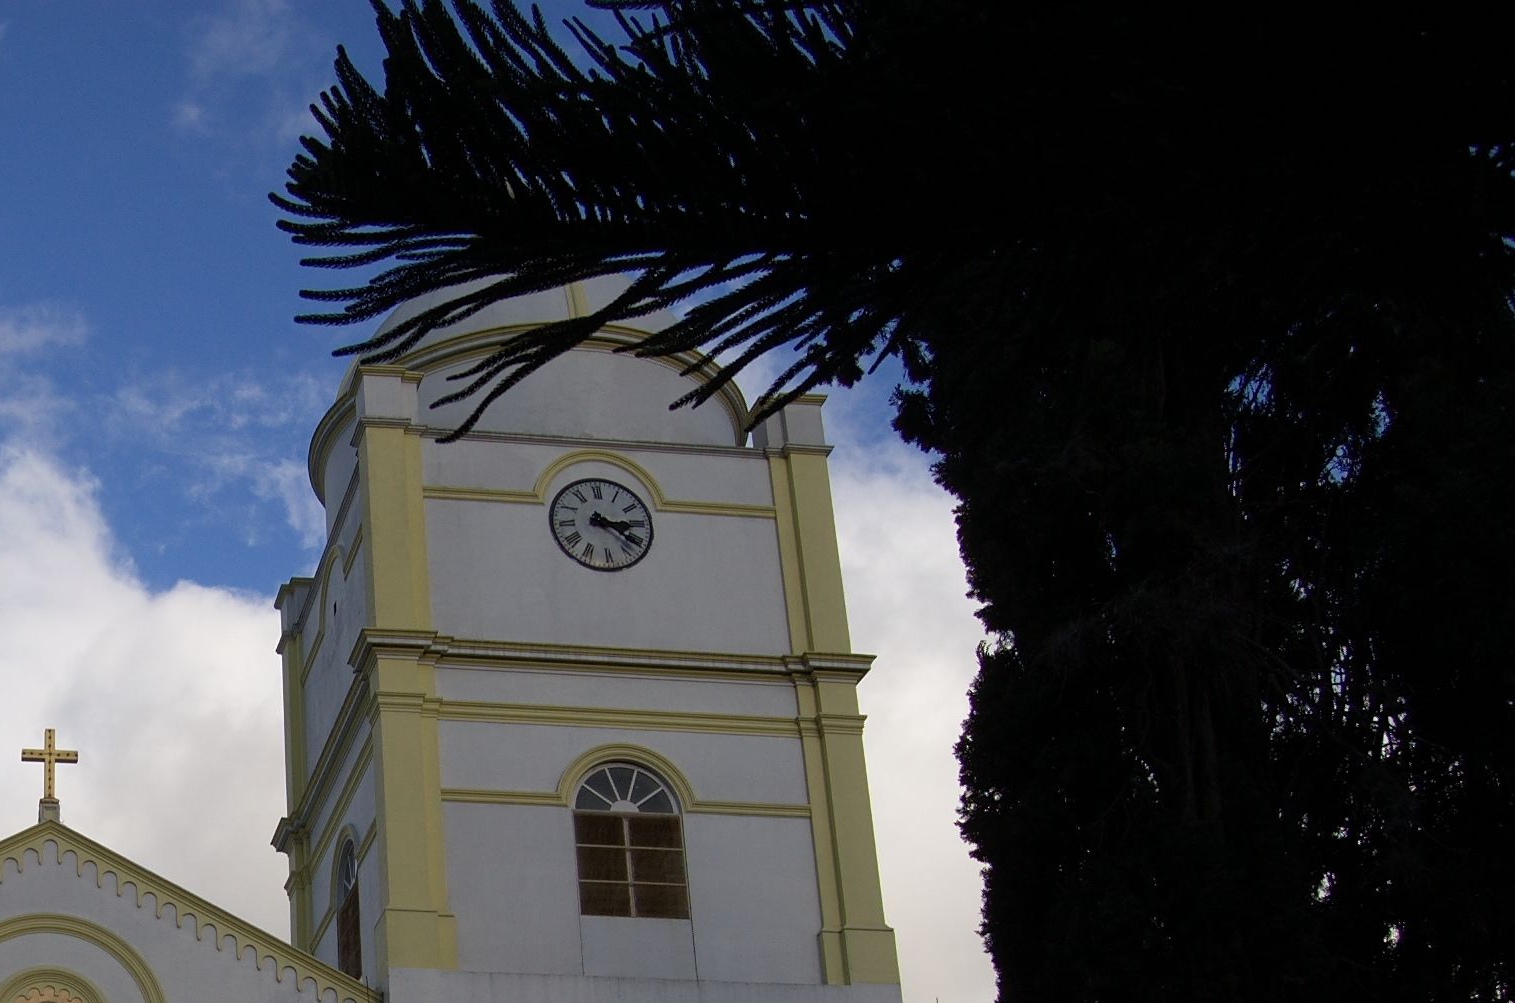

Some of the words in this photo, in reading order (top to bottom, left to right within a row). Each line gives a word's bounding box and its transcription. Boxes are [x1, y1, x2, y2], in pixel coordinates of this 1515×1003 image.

[611, 490, 619, 503] I
[621, 502, 637, 513] II
[627, 519, 645, 528] III
